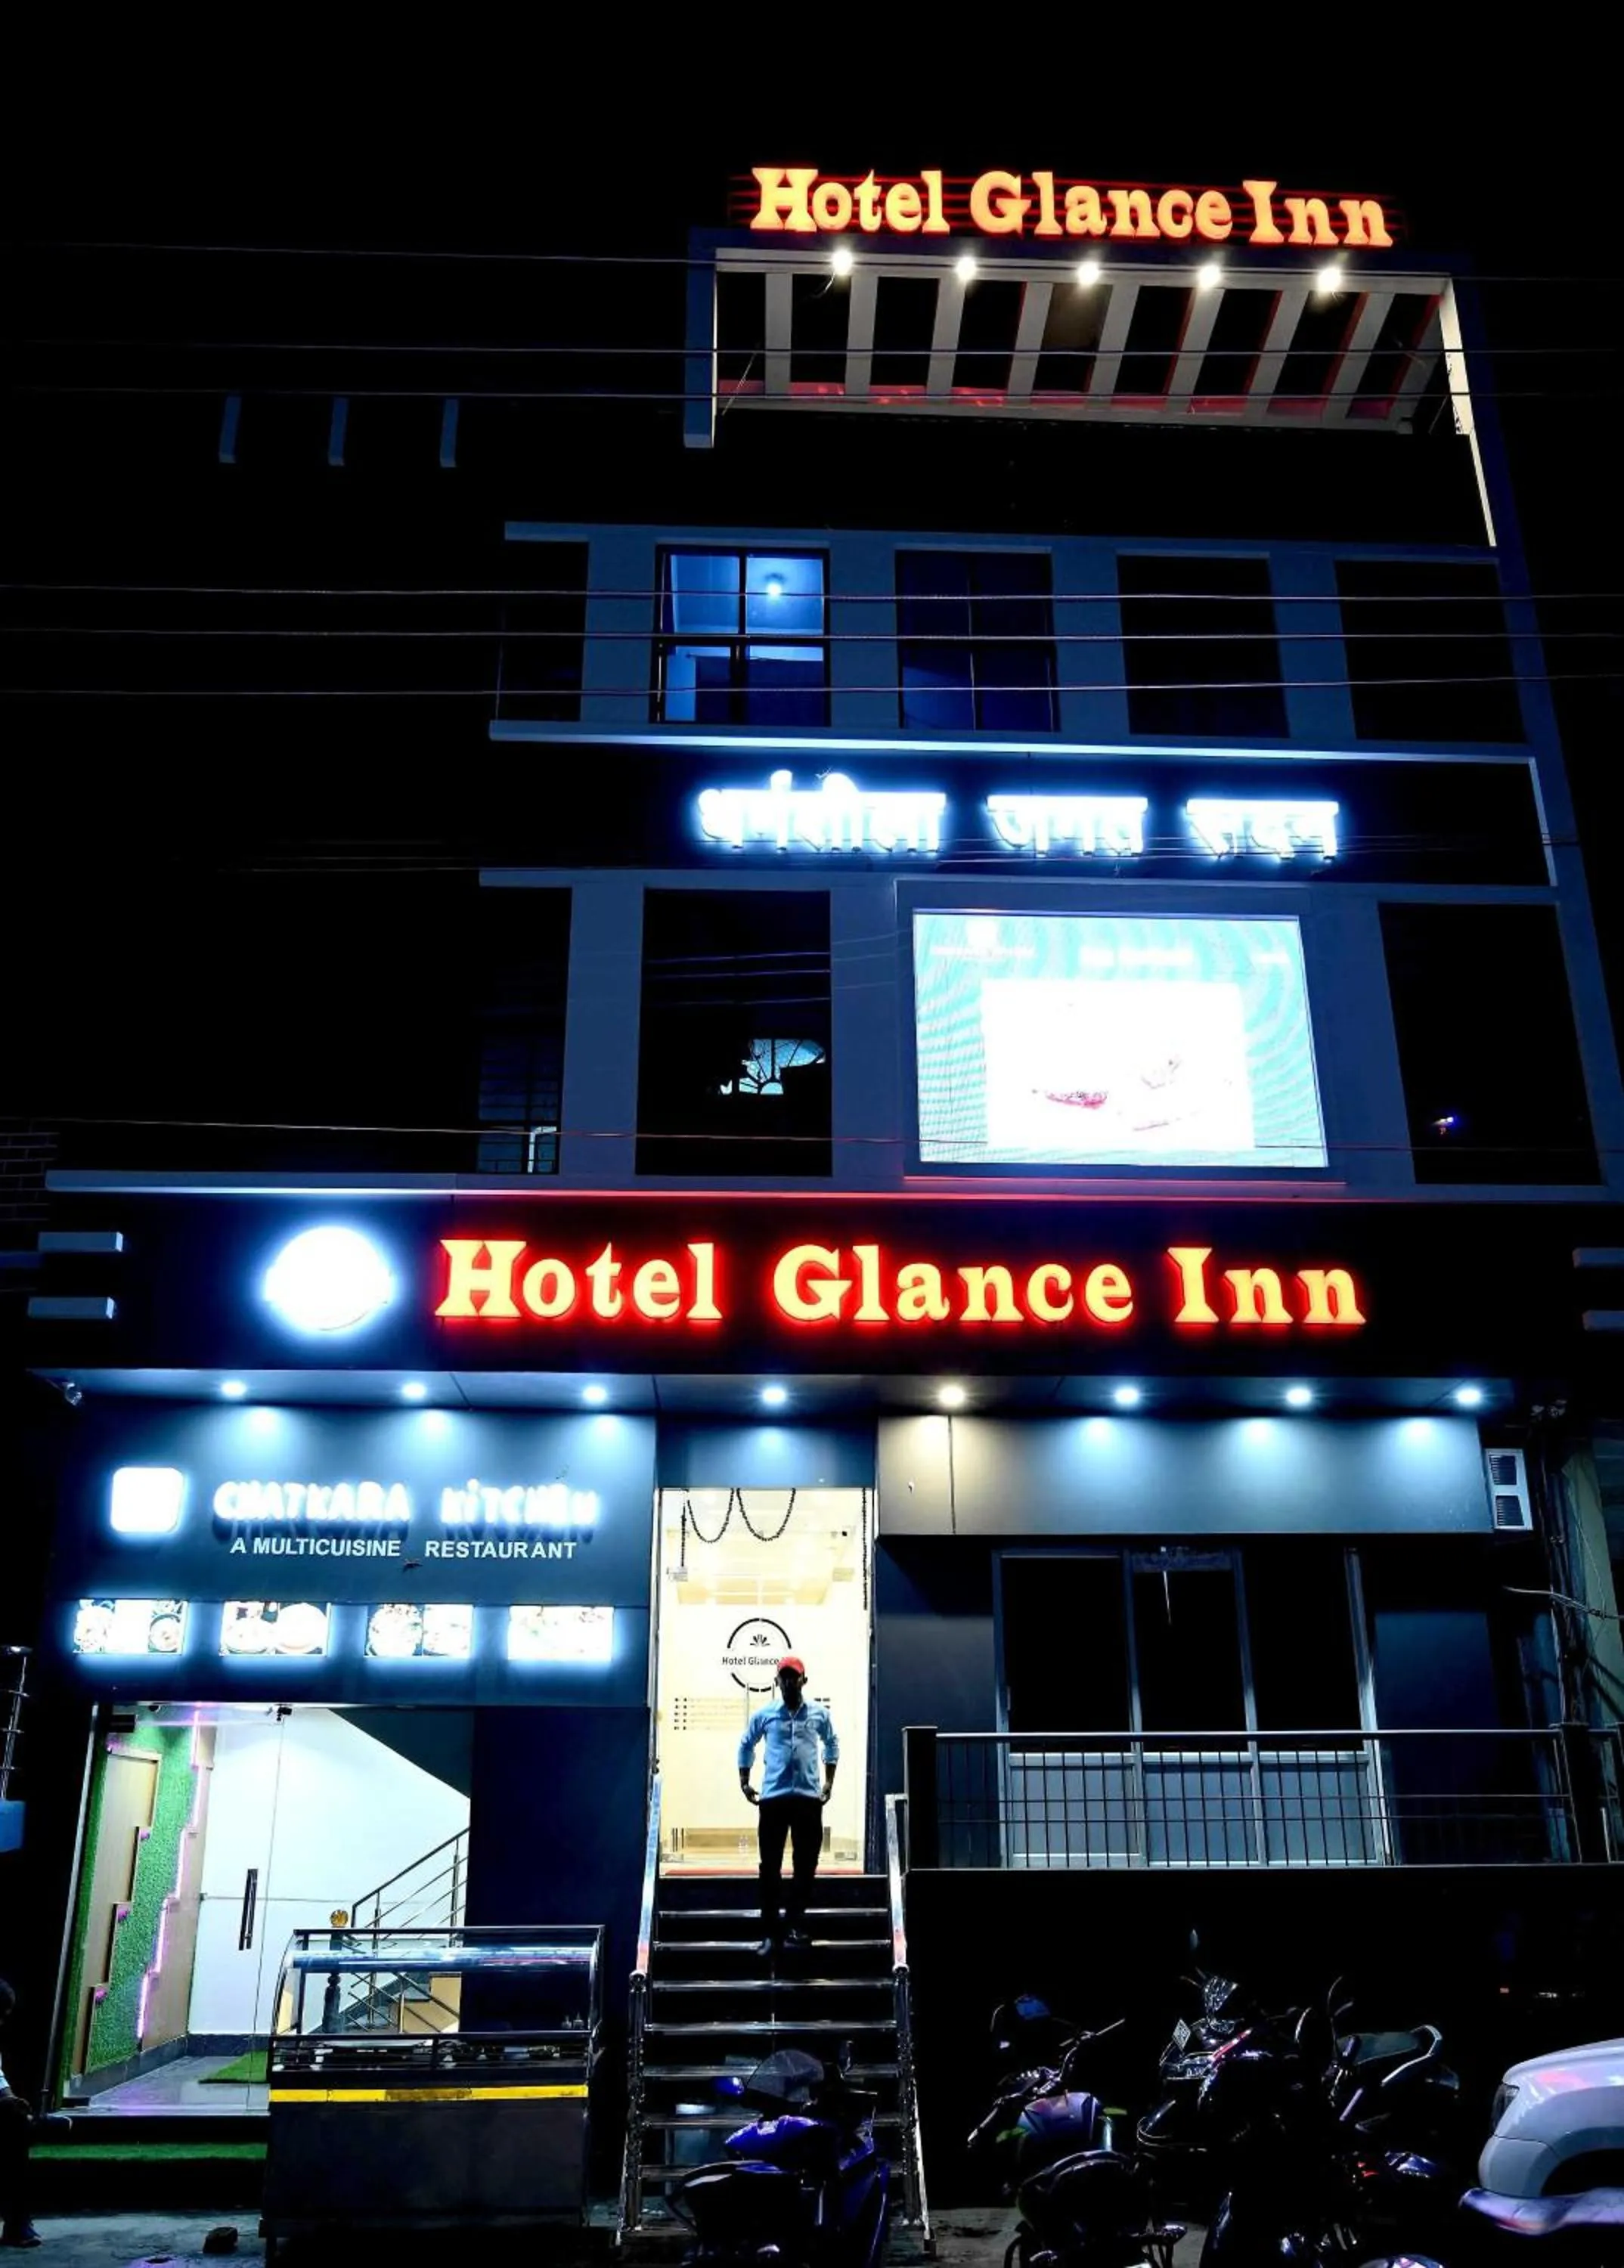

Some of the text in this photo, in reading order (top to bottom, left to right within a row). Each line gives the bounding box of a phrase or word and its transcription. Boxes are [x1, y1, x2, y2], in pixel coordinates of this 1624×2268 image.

[751, 167, 1393, 246] Hotel Glance Inn
[435, 1238, 1366, 1325] Hotel Glance Inn
[230, 1537, 577, 1559] A MULTICUISINE RESTAURANT
[722, 1656, 746, 1665] Hotel
